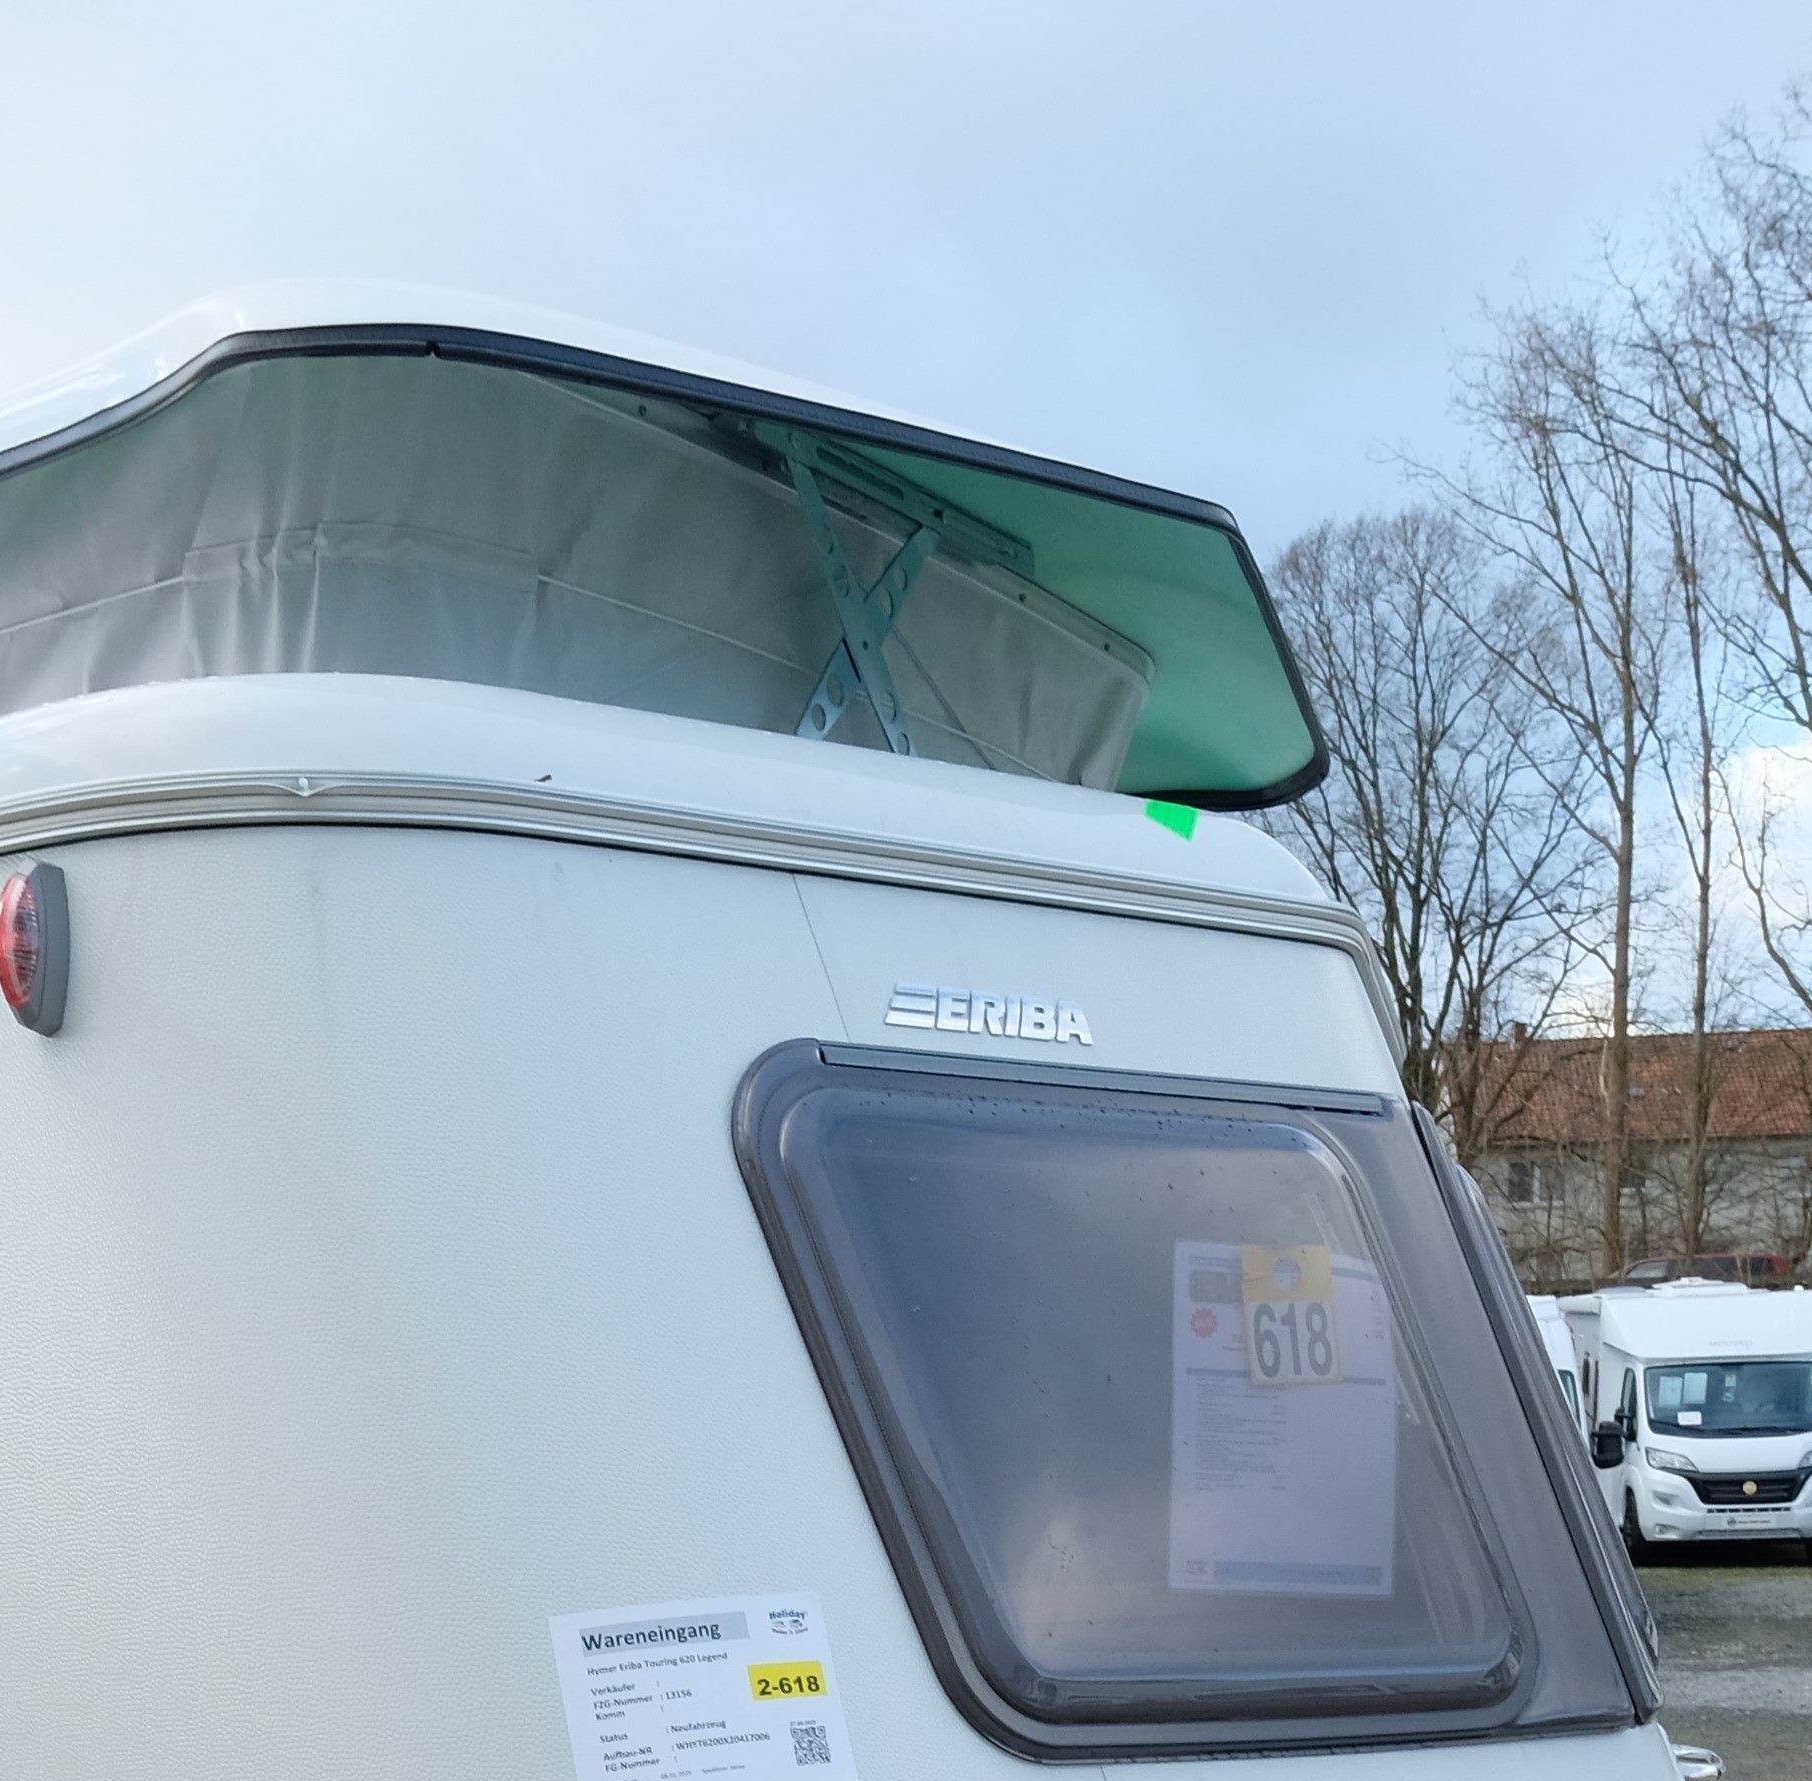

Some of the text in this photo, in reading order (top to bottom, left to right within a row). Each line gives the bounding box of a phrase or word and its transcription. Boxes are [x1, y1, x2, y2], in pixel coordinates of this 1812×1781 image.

[935, 985, 1094, 1046] ERIBA
[1253, 1301, 1334, 1378] 618
[581, 1623, 722, 1651] Wareneingang
[587, 1651, 729, 1677] Hymer Eriba Touring 620 Legend
[757, 1675, 820, 1696] 2-618
[599, 1733, 629, 1744] Status
